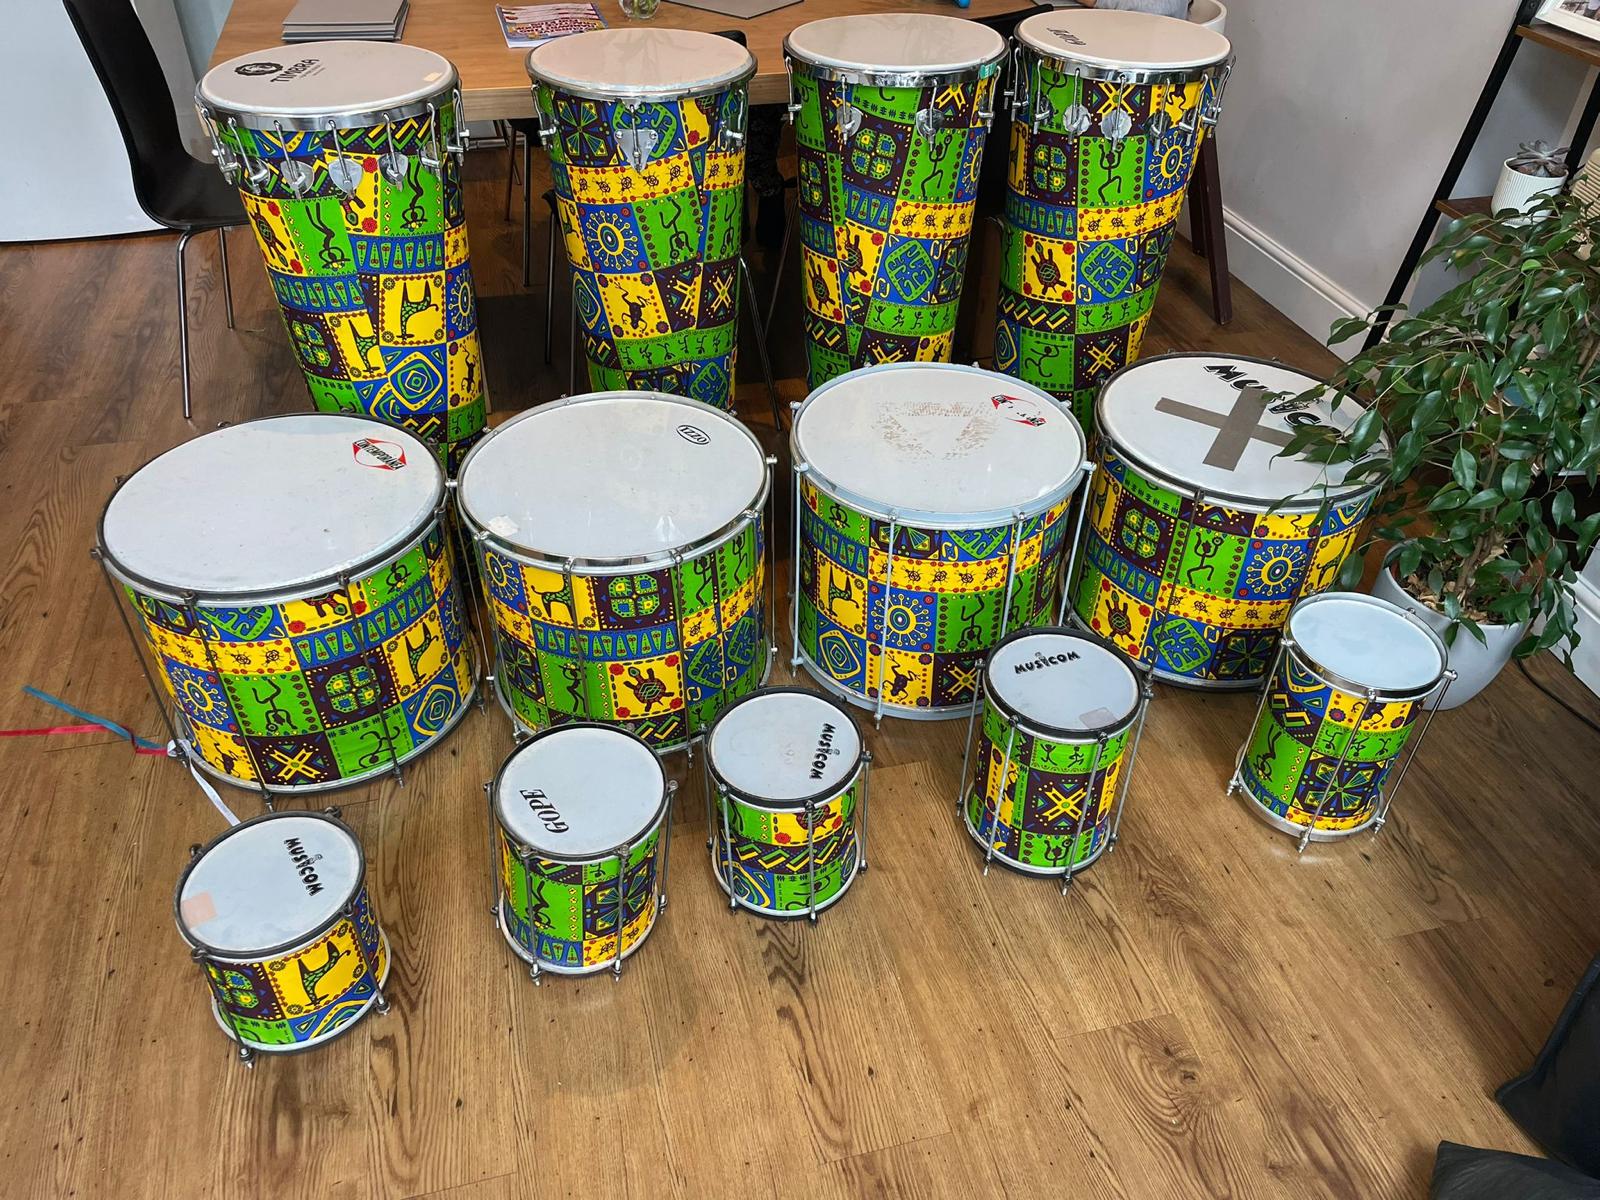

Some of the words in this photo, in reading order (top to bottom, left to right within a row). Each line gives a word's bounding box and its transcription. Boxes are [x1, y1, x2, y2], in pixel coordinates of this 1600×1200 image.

[270, 59, 320, 82] TIMBRA
[679, 427, 708, 443] IZZO
[1014, 651, 1081, 674] MUSICOM
[809, 723, 838, 780] MUSICOM
[519, 789, 569, 833] GOPE
[284, 837, 325, 897] MUSICOM
